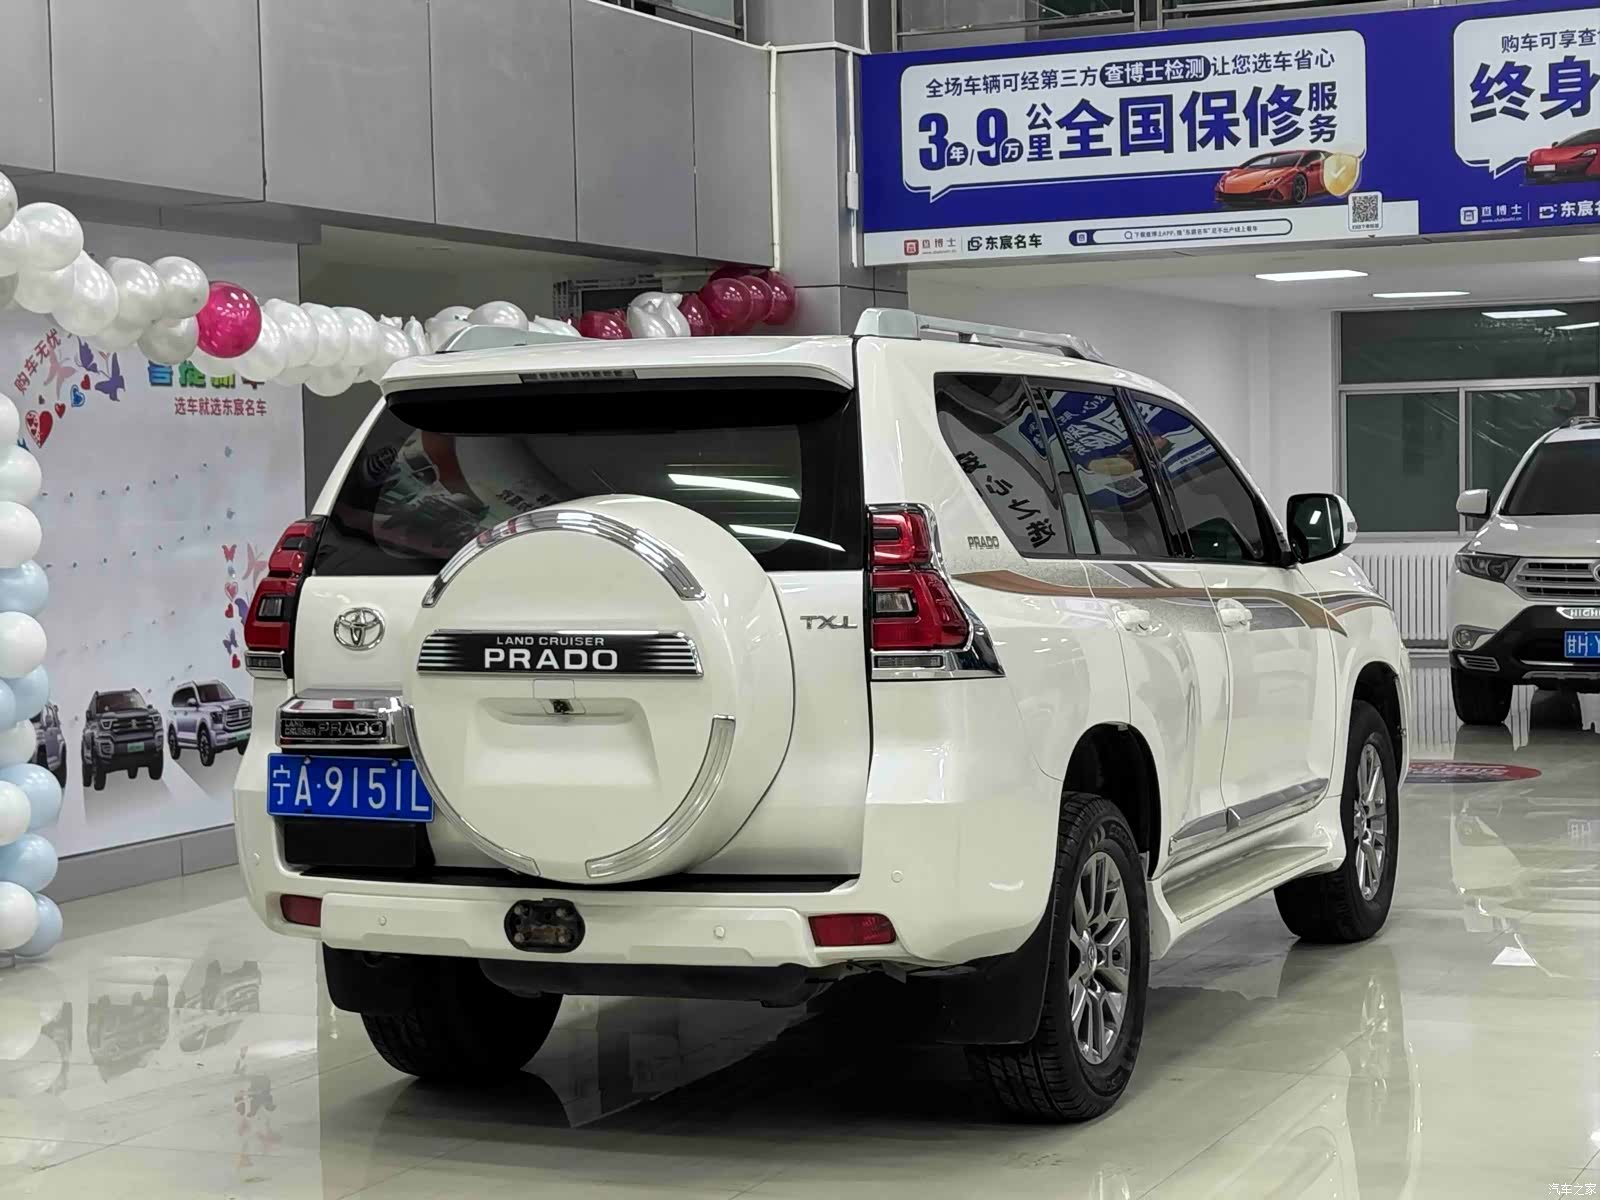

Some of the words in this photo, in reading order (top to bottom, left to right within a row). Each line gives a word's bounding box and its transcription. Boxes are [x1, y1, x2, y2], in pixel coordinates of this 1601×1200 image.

[1501, 27, 1601, 53] 购车可享查
[1470, 55, 1601, 123] 终身
[985, 233, 1042, 250] 东宸名车
[174, 396, 267, 417] 选车就选东宸名车
[967, 535, 1000, 550] PRADO
[1570, 609, 1601, 617] HIGH
[496, 636, 535, 646] LAND
[538, 636, 605, 646] CRUISER
[484, 648, 618, 670] PRADO
[285, 719, 304, 727] LAND
[318, 721, 383, 736] PRADO
[285, 727, 316, 736] CRUISER
